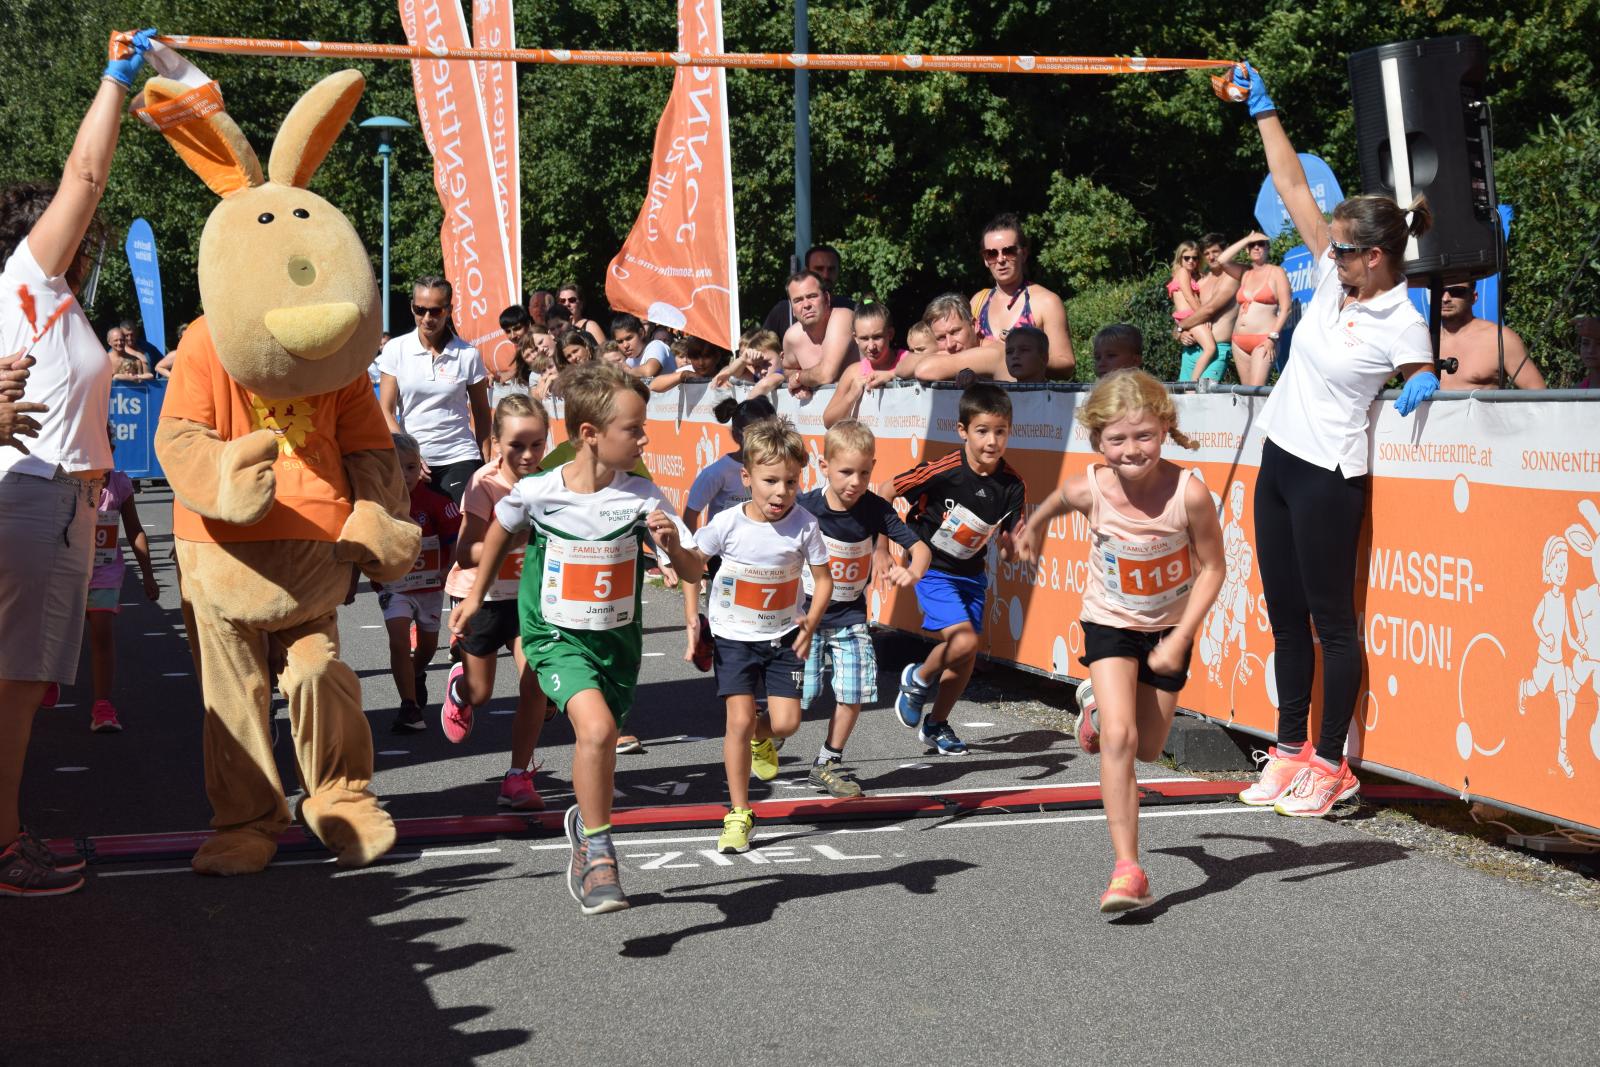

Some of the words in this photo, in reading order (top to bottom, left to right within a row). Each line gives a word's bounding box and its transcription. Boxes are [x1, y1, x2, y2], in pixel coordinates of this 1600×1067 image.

[385, 47, 413, 55] ACTION!
[450, 49, 503, 59] WASSER-SPASS
[572, 54, 624, 63] WASSER-SPASS
[692, 56, 742, 66] WASSER-SPASS
[749, 58, 775, 66] ACTION!
[809, 59, 860, 68] WASSER-SPASS
[648, 452, 656, 473] ZU
[656, 453, 686, 478] WASSER-
[612, 508, 638, 516] NEUBERG
[96, 529, 108, 547] 9
[1122, 544, 1150, 553] FAMILY
[1151, 541, 1168, 551] RUN
[744, 568, 769, 576] FAMILY
[830, 561, 860, 580] 86
[1050, 557, 1060, 591] &
[1128, 559, 1184, 591] 119
[1367, 546, 1484, 604] WASSER-
[593, 570, 612, 599] 5
[761, 588, 777, 609] 7
[586, 605, 615, 614] Jannik
[551, 673, 561, 692] 3
